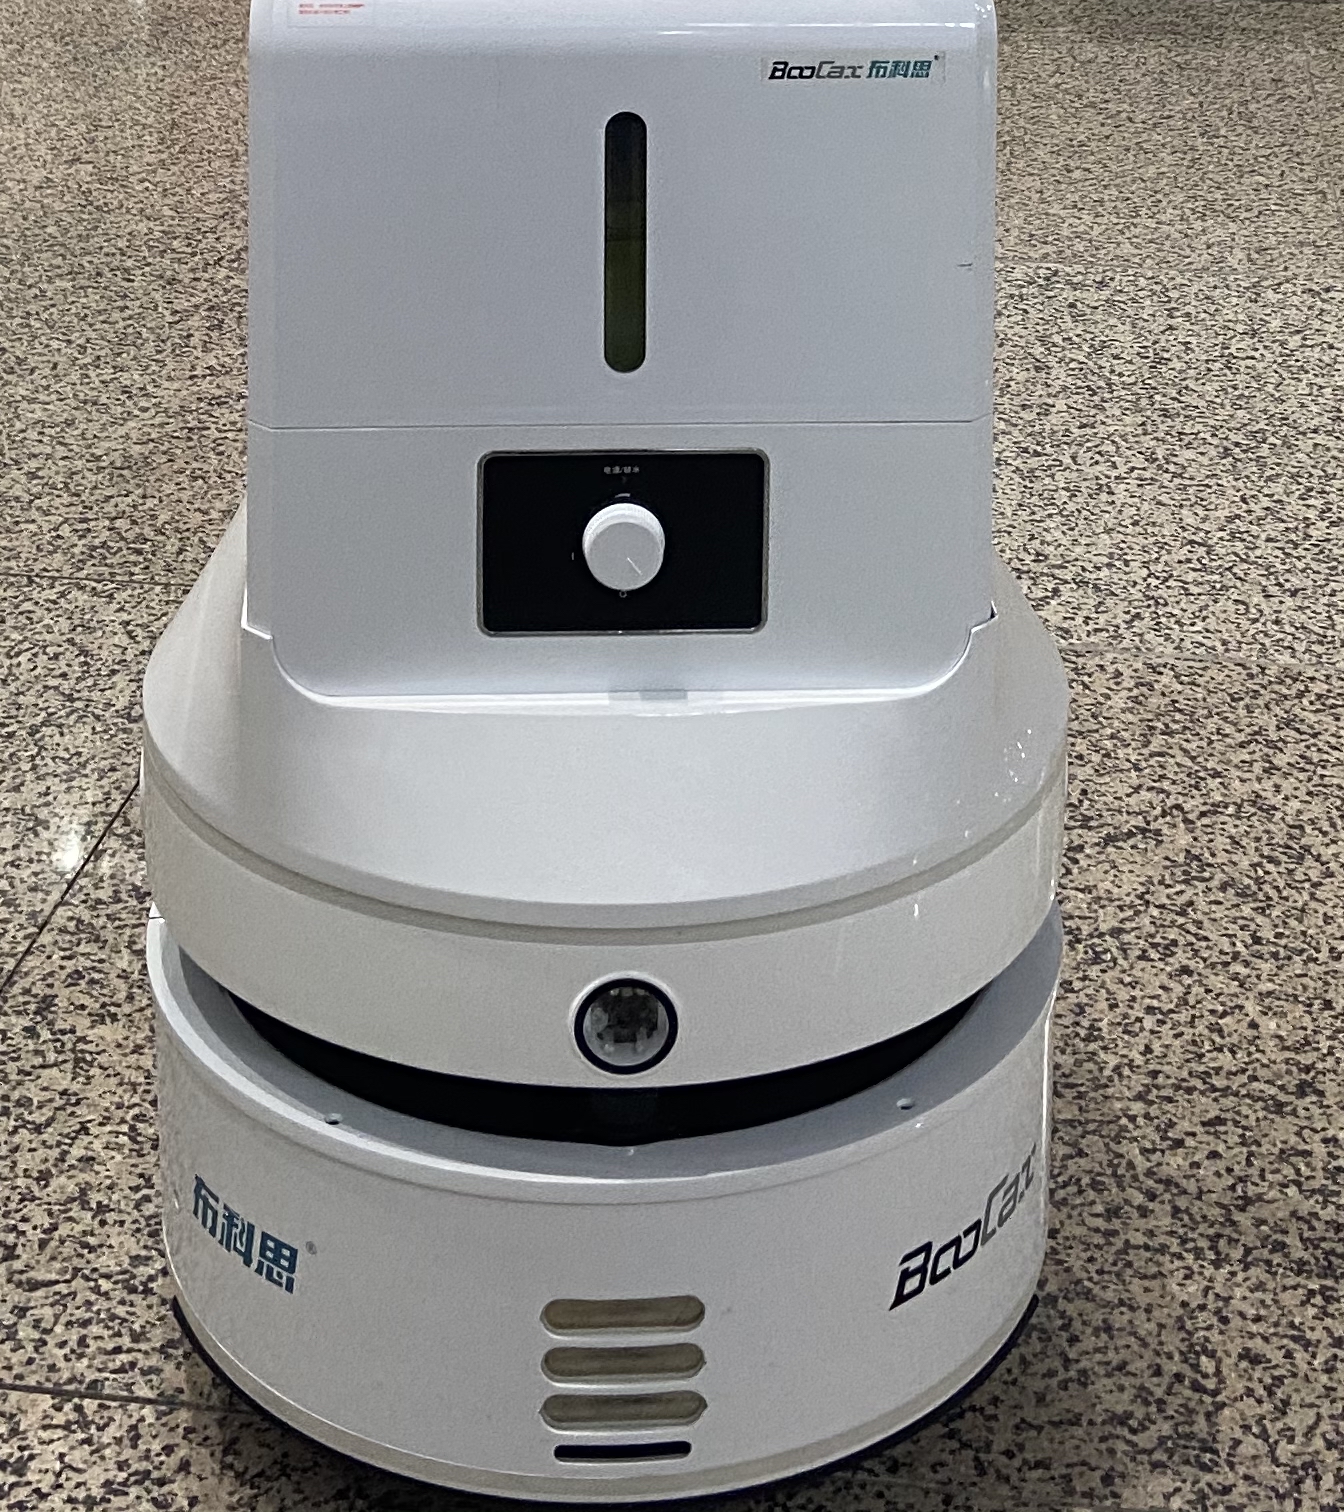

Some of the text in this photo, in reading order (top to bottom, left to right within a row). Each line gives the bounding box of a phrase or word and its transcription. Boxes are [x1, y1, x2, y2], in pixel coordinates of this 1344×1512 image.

[866, 59, 933, 79] 布科思
[192, 1173, 299, 1295] 布科思
